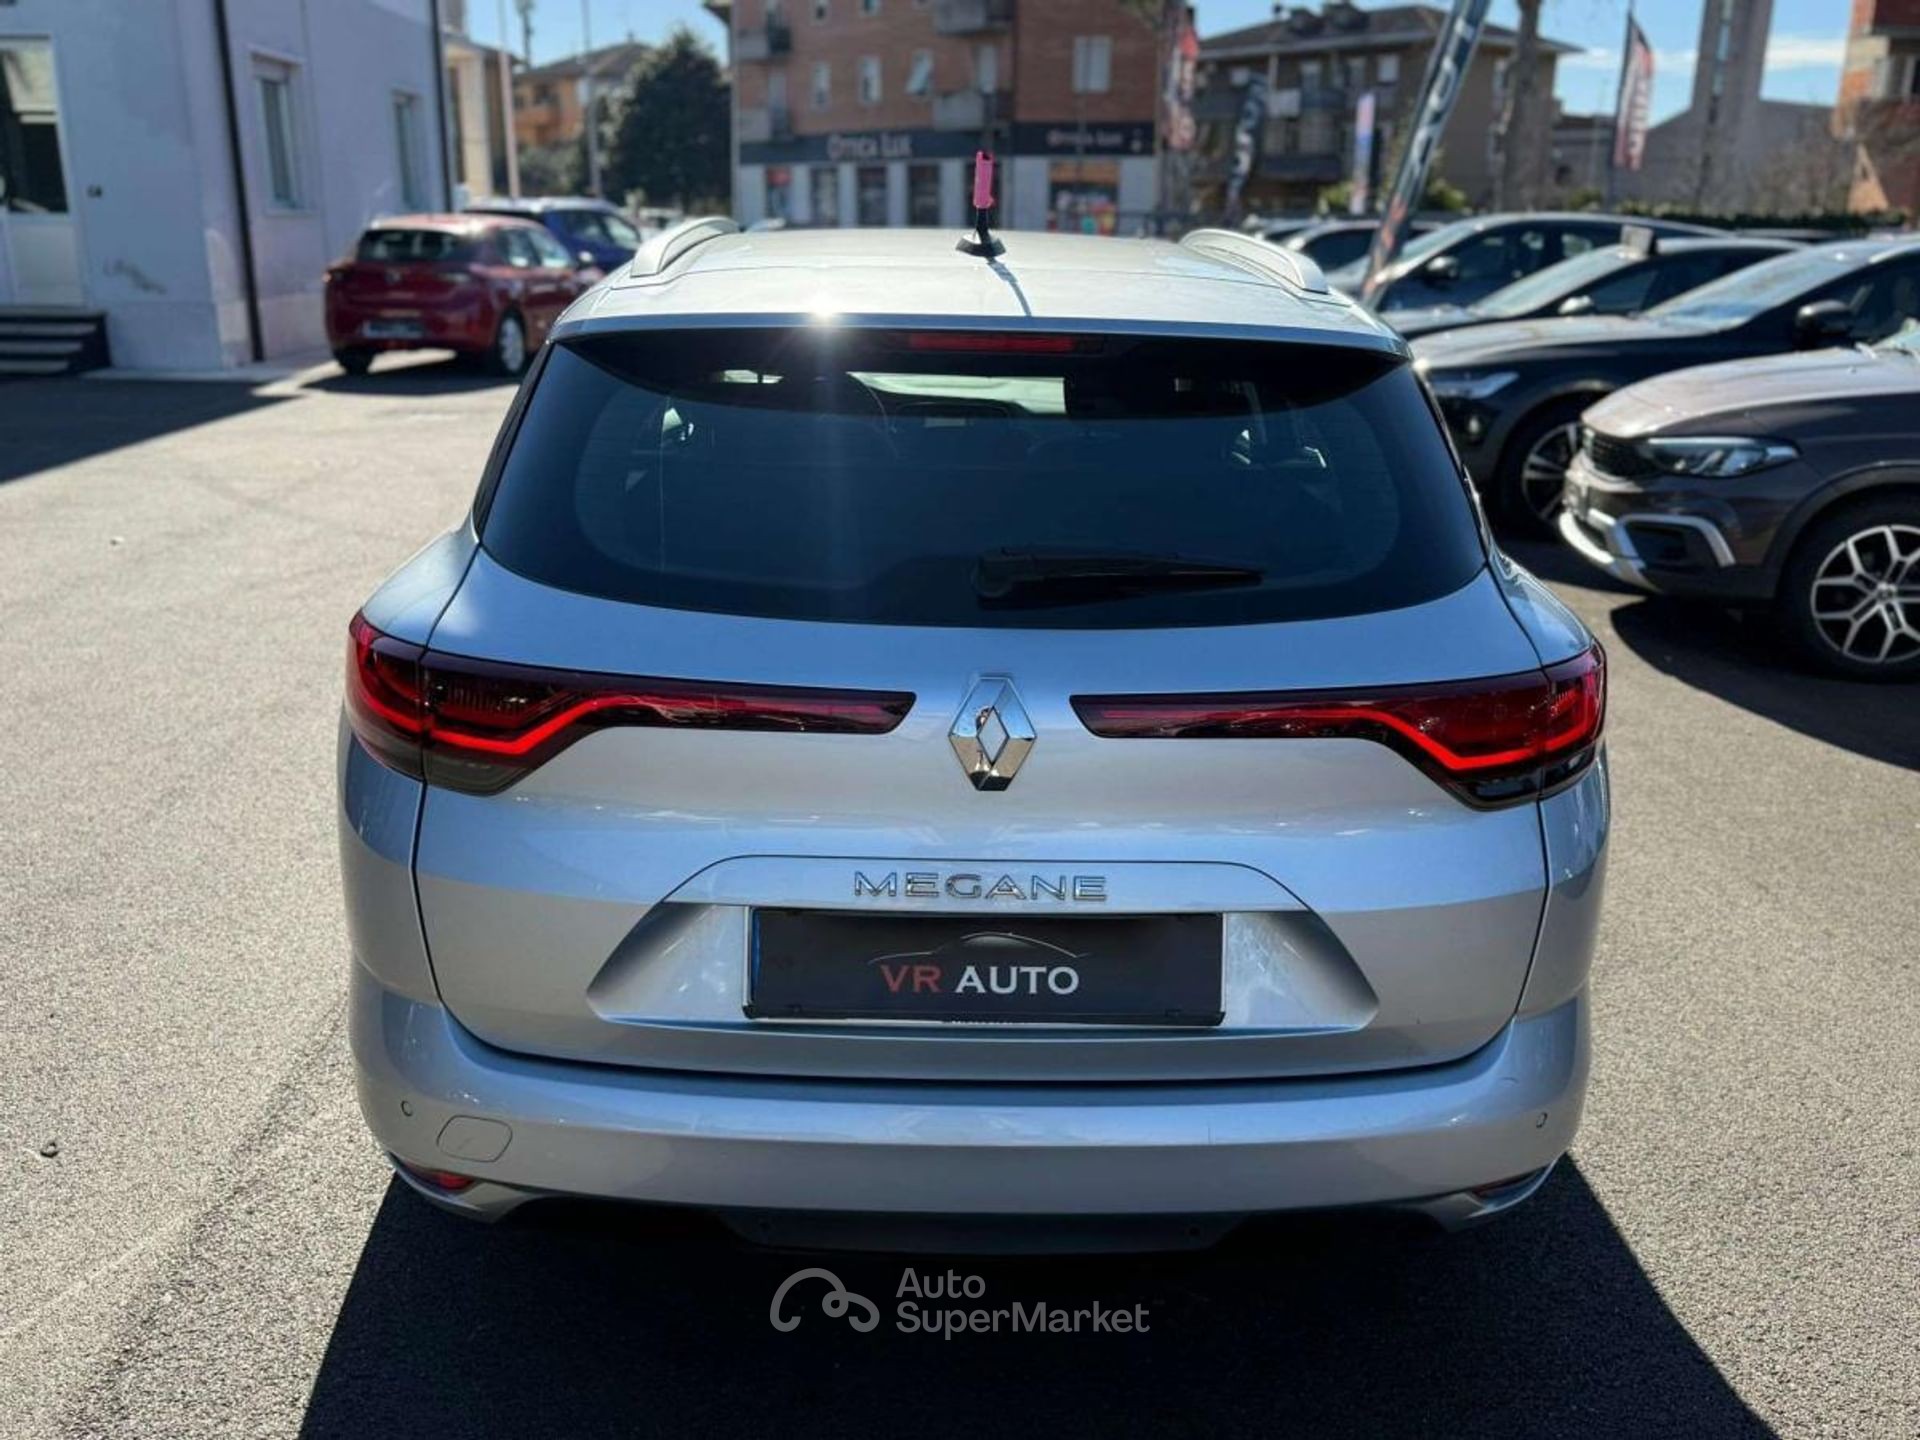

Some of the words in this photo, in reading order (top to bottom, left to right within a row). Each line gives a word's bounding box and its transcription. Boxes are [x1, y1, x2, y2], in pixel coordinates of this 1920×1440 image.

[853, 871, 1108, 901] MEGANE
[881, 964, 943, 993] VR
[955, 965, 1080, 994] AUTO
